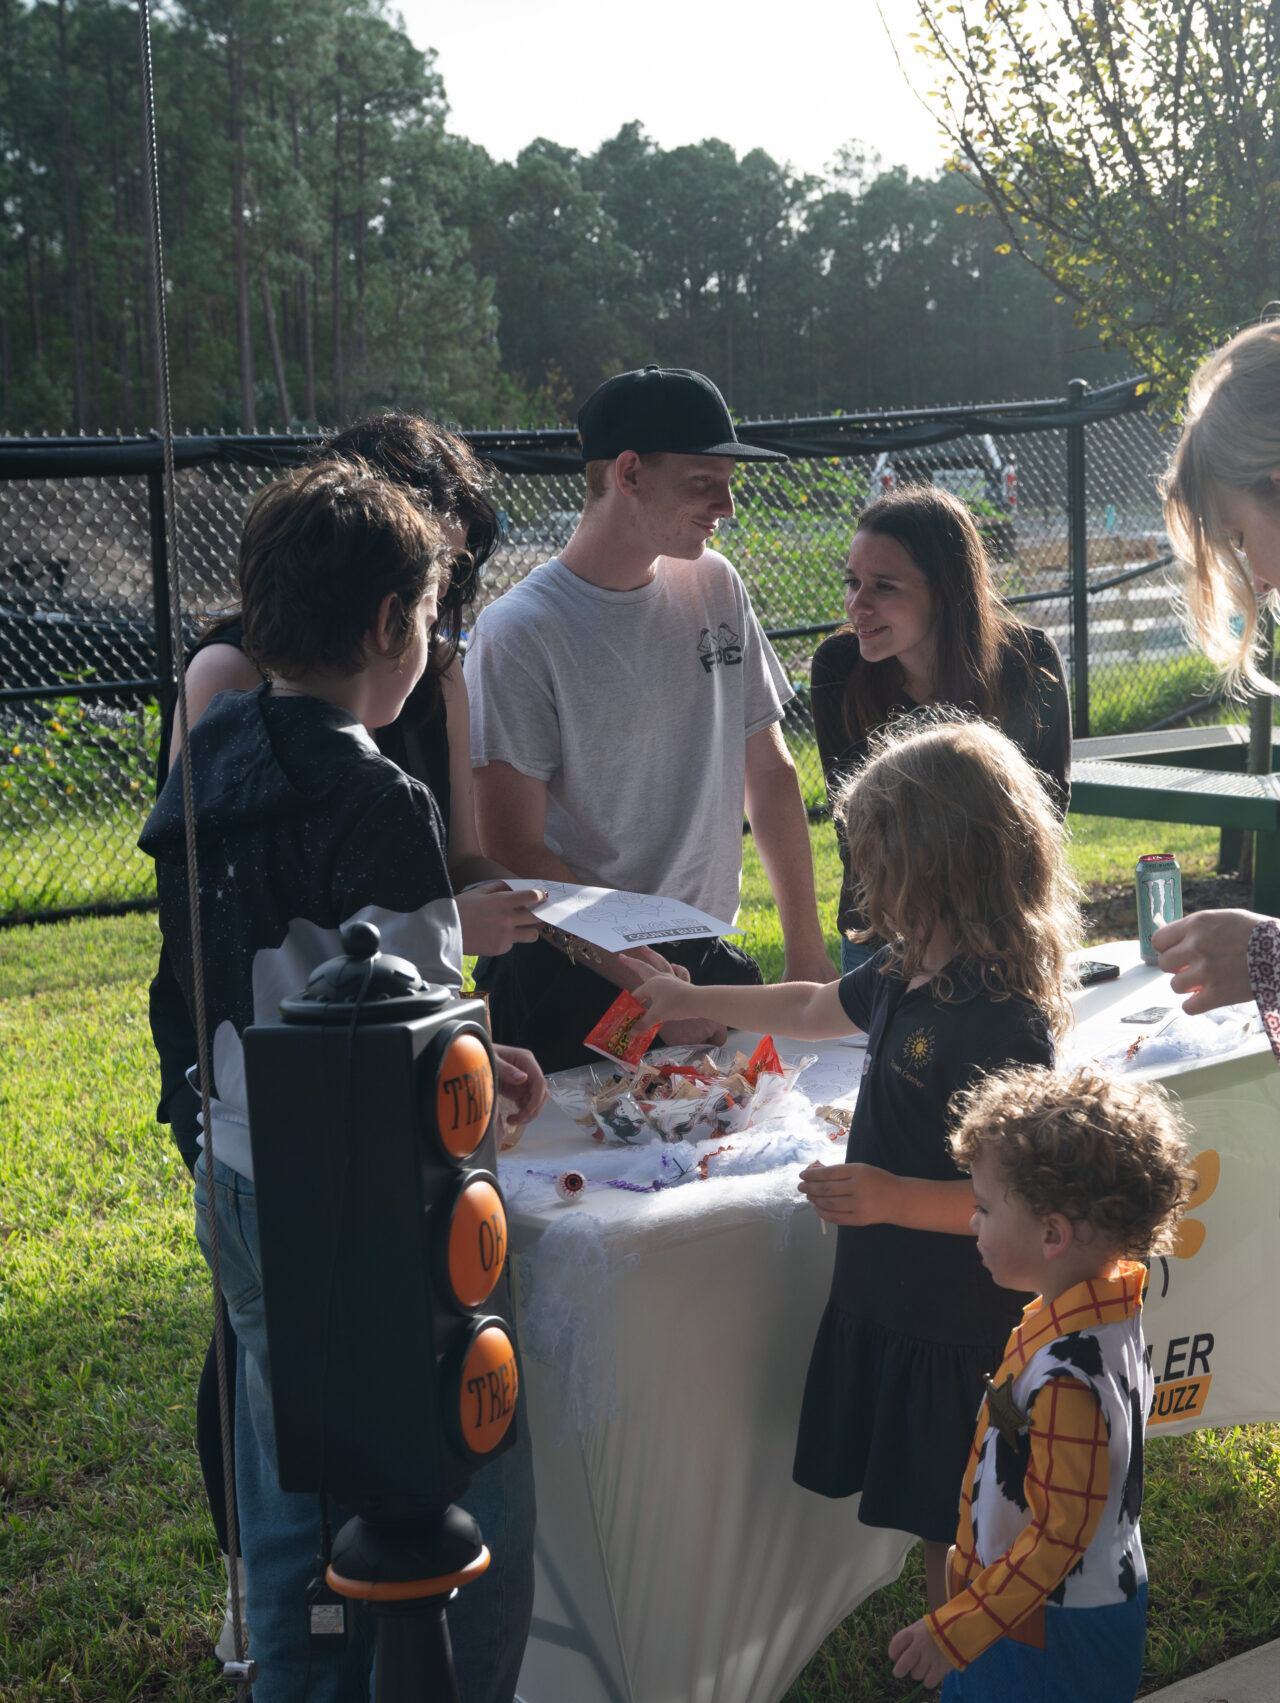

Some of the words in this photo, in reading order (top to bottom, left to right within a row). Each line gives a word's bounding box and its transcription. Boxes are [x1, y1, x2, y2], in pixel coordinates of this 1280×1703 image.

[628, 930, 674, 941] COUNTY
[677, 926, 708, 936] BUZZ
[479, 1213, 505, 1272] OR
